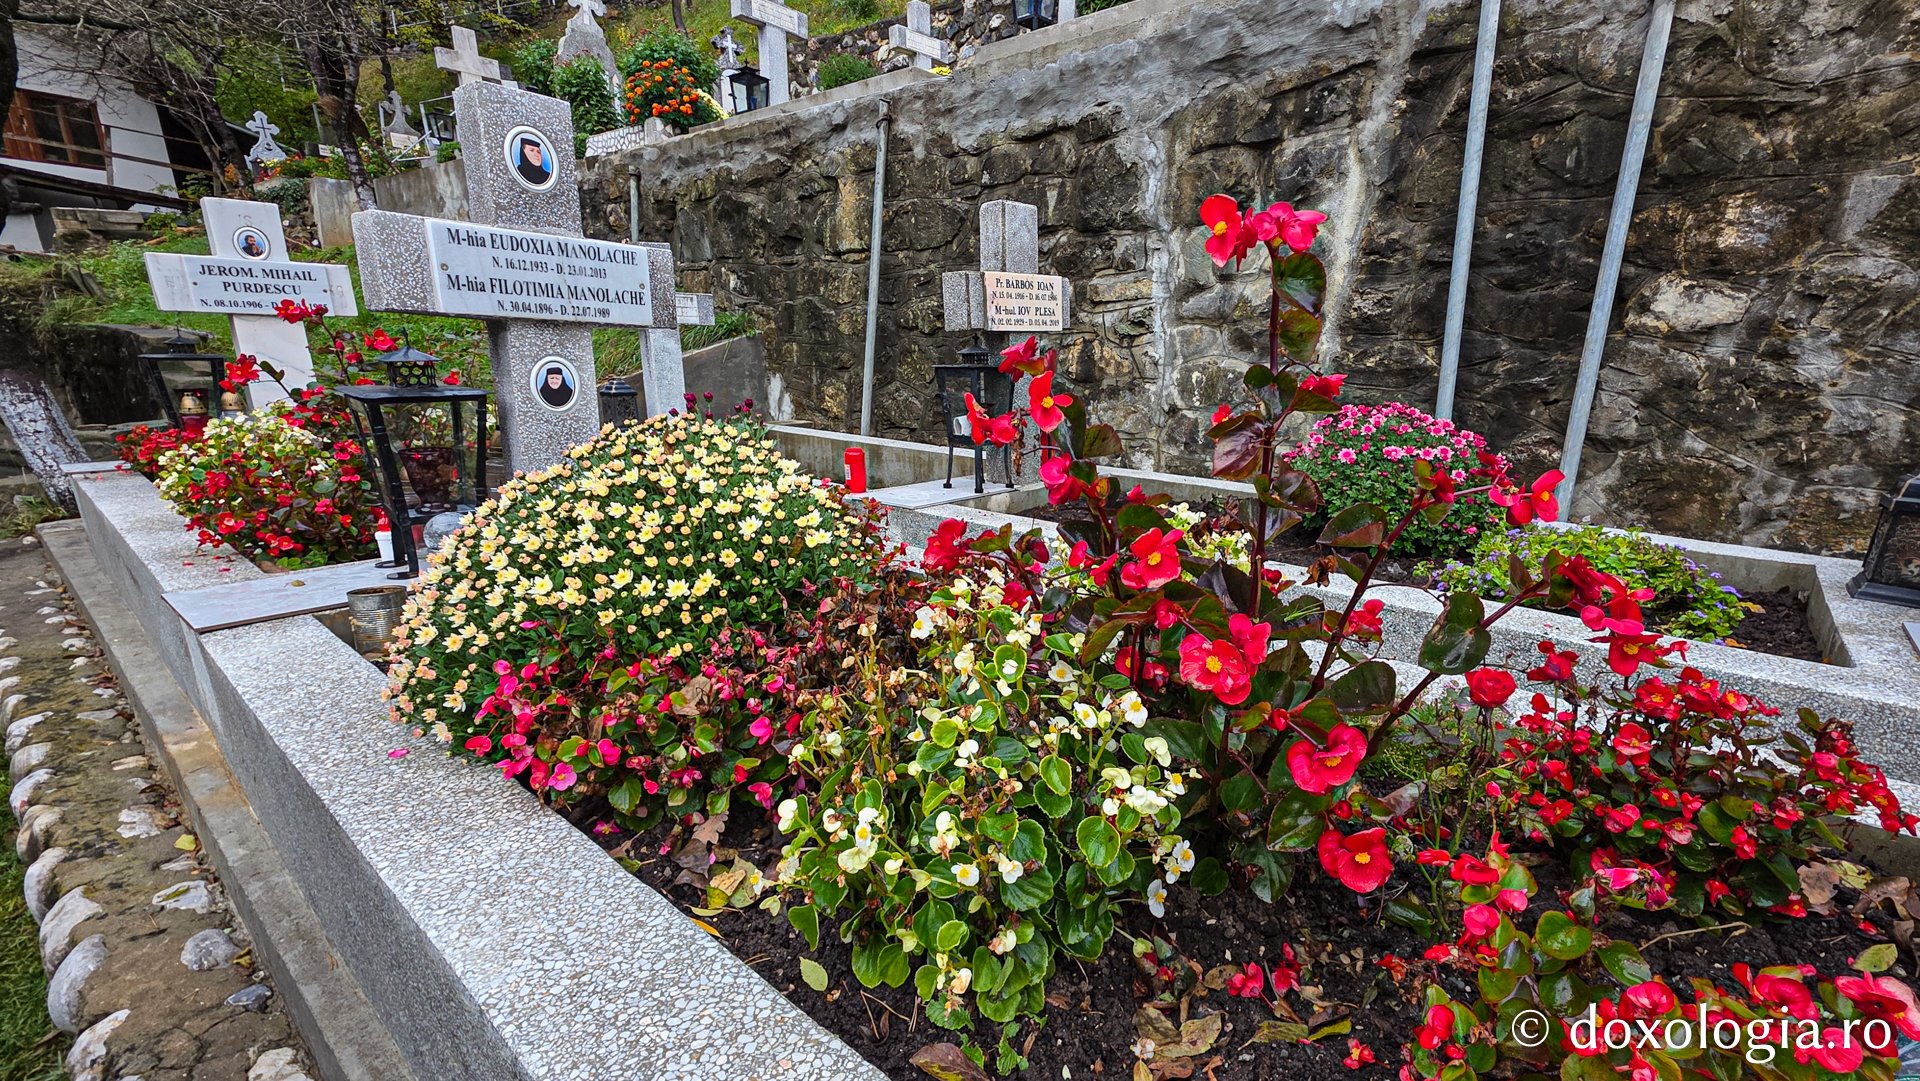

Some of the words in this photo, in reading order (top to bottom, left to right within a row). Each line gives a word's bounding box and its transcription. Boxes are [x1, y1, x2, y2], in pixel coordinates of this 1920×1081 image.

[446, 227, 487, 248] M-hia
[489, 233, 555, 256] EUDOXIA
[557, 241, 639, 266] MANOLACHE
[199, 264, 258, 278] JEROM.
[261, 268, 317, 281] MIHAIL
[492, 256, 503, 268] N.
[505, 258, 549, 273] 16.12.1933
[556, 263, 566, 275] D.
[567, 265, 607, 279] 23.01.2013
[222, 281, 302, 295] PURDESCU
[446, 273, 487, 293] M-hia
[489, 277, 564, 300] FILOTIMIA
[566, 285, 646, 306] MANOLACHE
[1037, 281, 1054, 291] IOAN
[200, 298, 212, 307] N.
[213, 299, 263, 309] 08.10.1906
[497, 299, 508, 312] N.
[509, 300, 553, 315] 30.04.1896
[560, 304, 570, 316] D.
[571, 305, 611, 318] 22.07.1989
[1018, 306, 1032, 316] IOV
